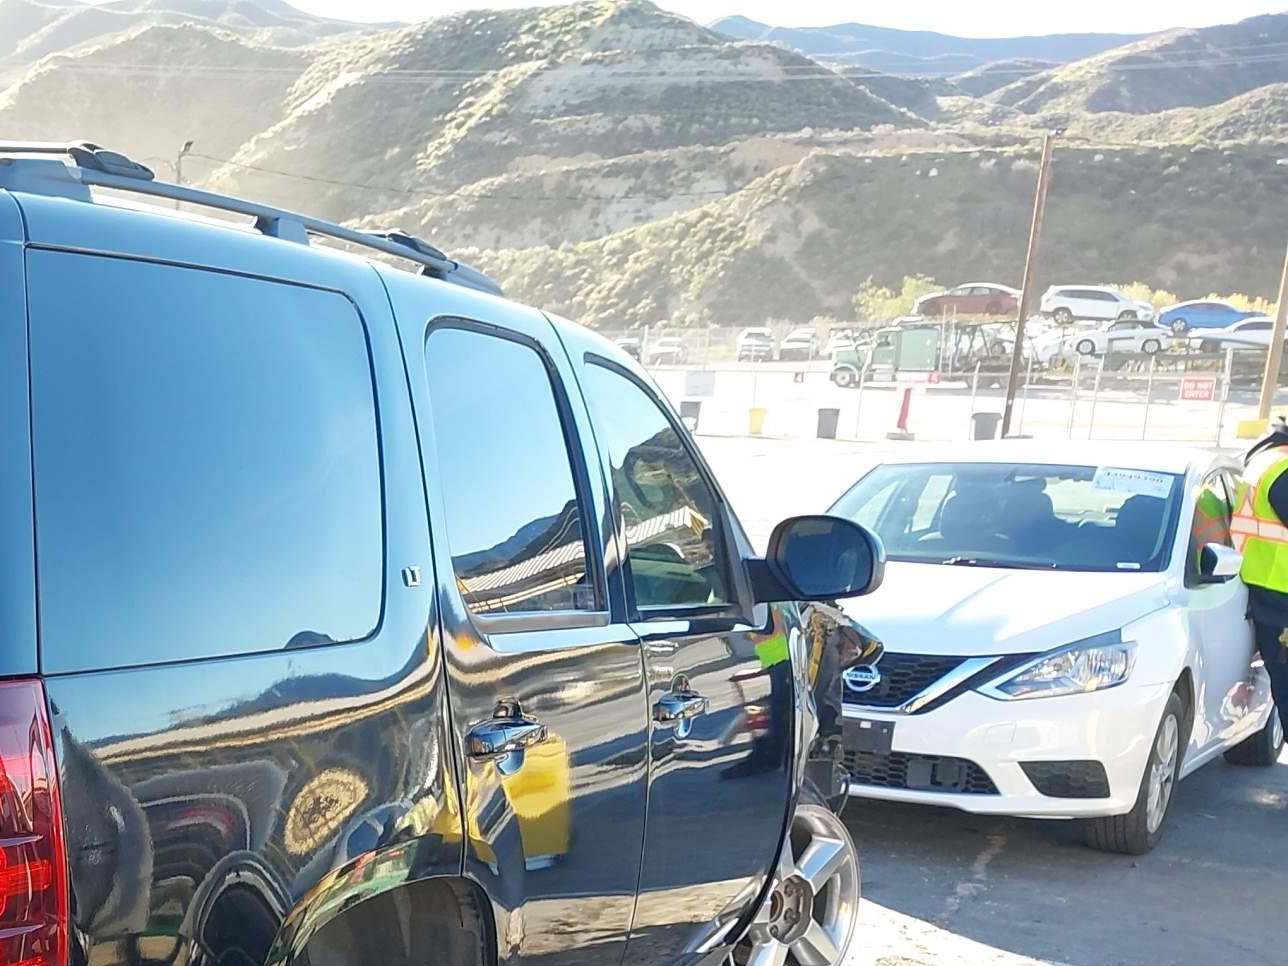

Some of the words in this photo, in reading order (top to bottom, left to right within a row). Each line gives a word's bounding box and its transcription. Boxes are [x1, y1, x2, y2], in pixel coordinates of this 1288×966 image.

[1183, 381, 1196, 391] DO
[1196, 381, 1213, 391] NOT
[1183, 390, 1210, 398] ENTER
[845, 671, 876, 680] NISSAN
